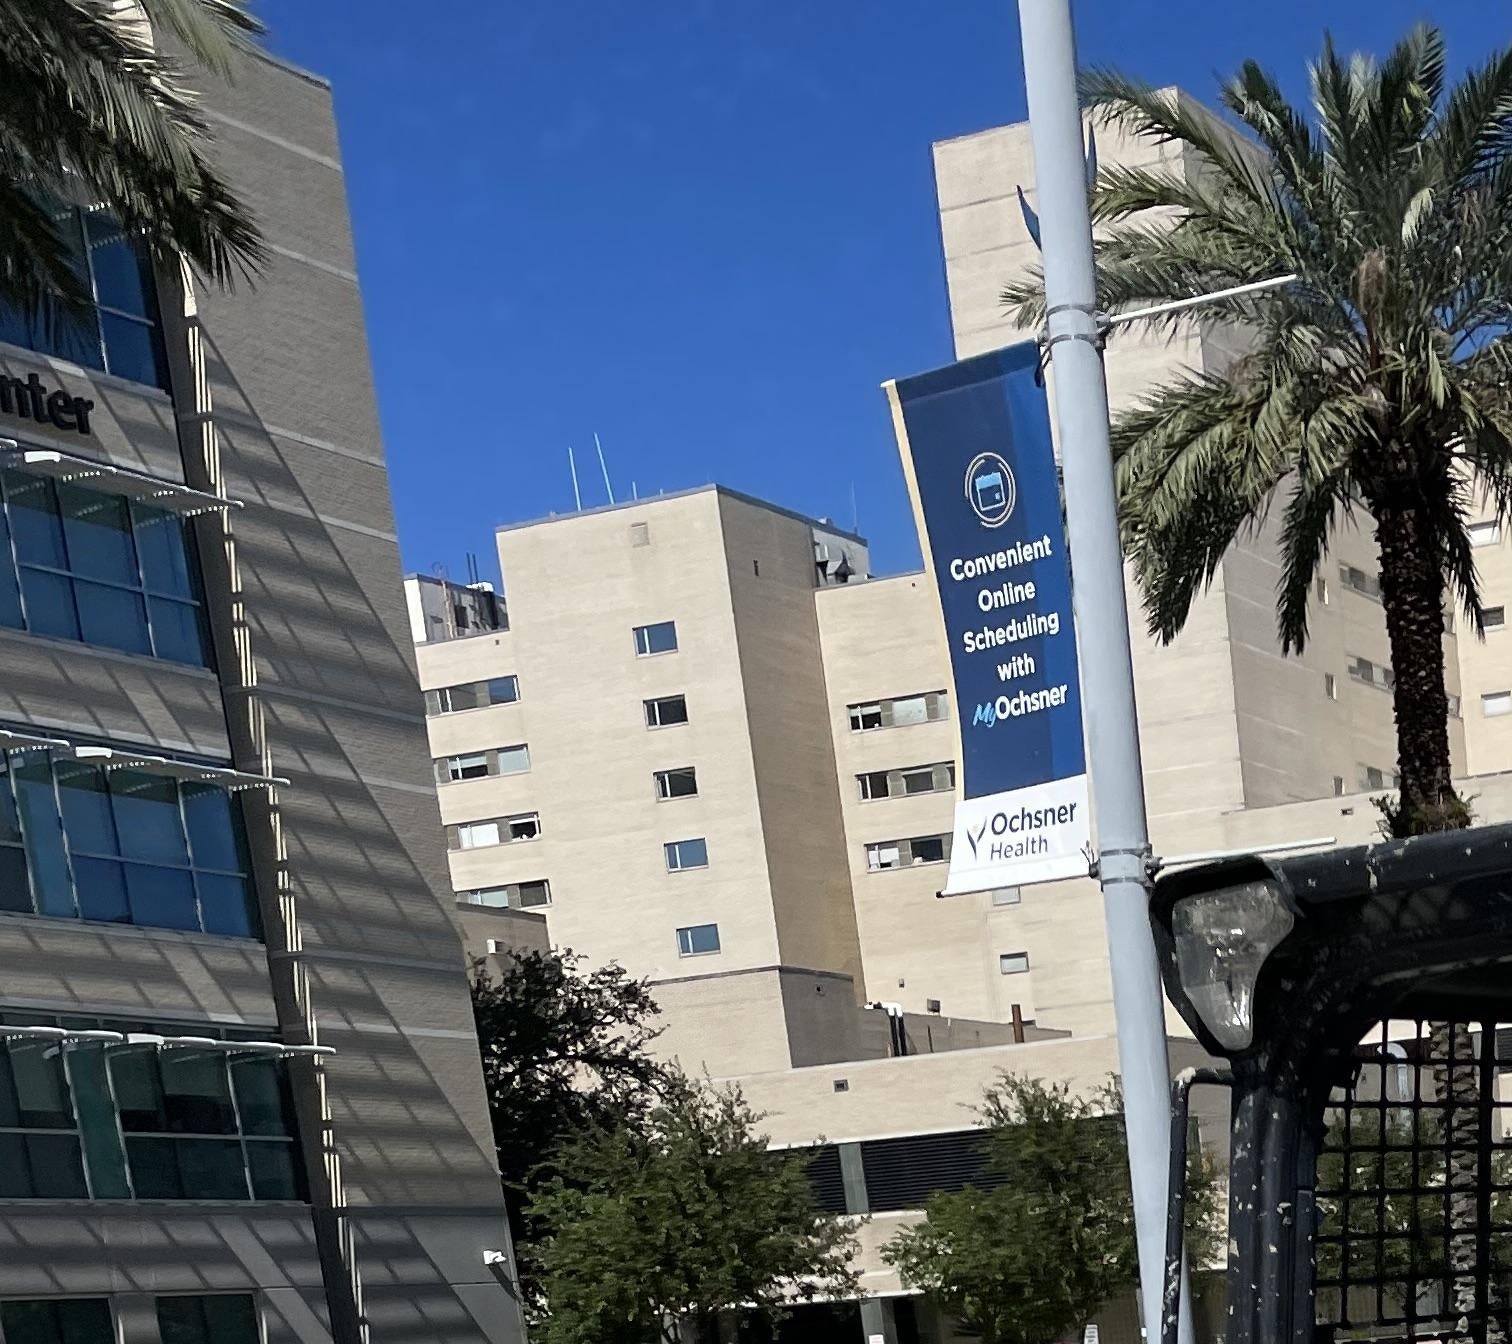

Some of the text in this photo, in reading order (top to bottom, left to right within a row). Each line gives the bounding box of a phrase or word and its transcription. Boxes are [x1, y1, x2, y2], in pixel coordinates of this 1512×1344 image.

[950, 534, 1053, 581] Convenient
[977, 581, 1036, 612] Online
[963, 612, 1060, 653] Scheduling
[997, 652, 1036, 682] with
[991, 802, 1078, 836] Ochsner
[990, 834, 1049, 861] Health
